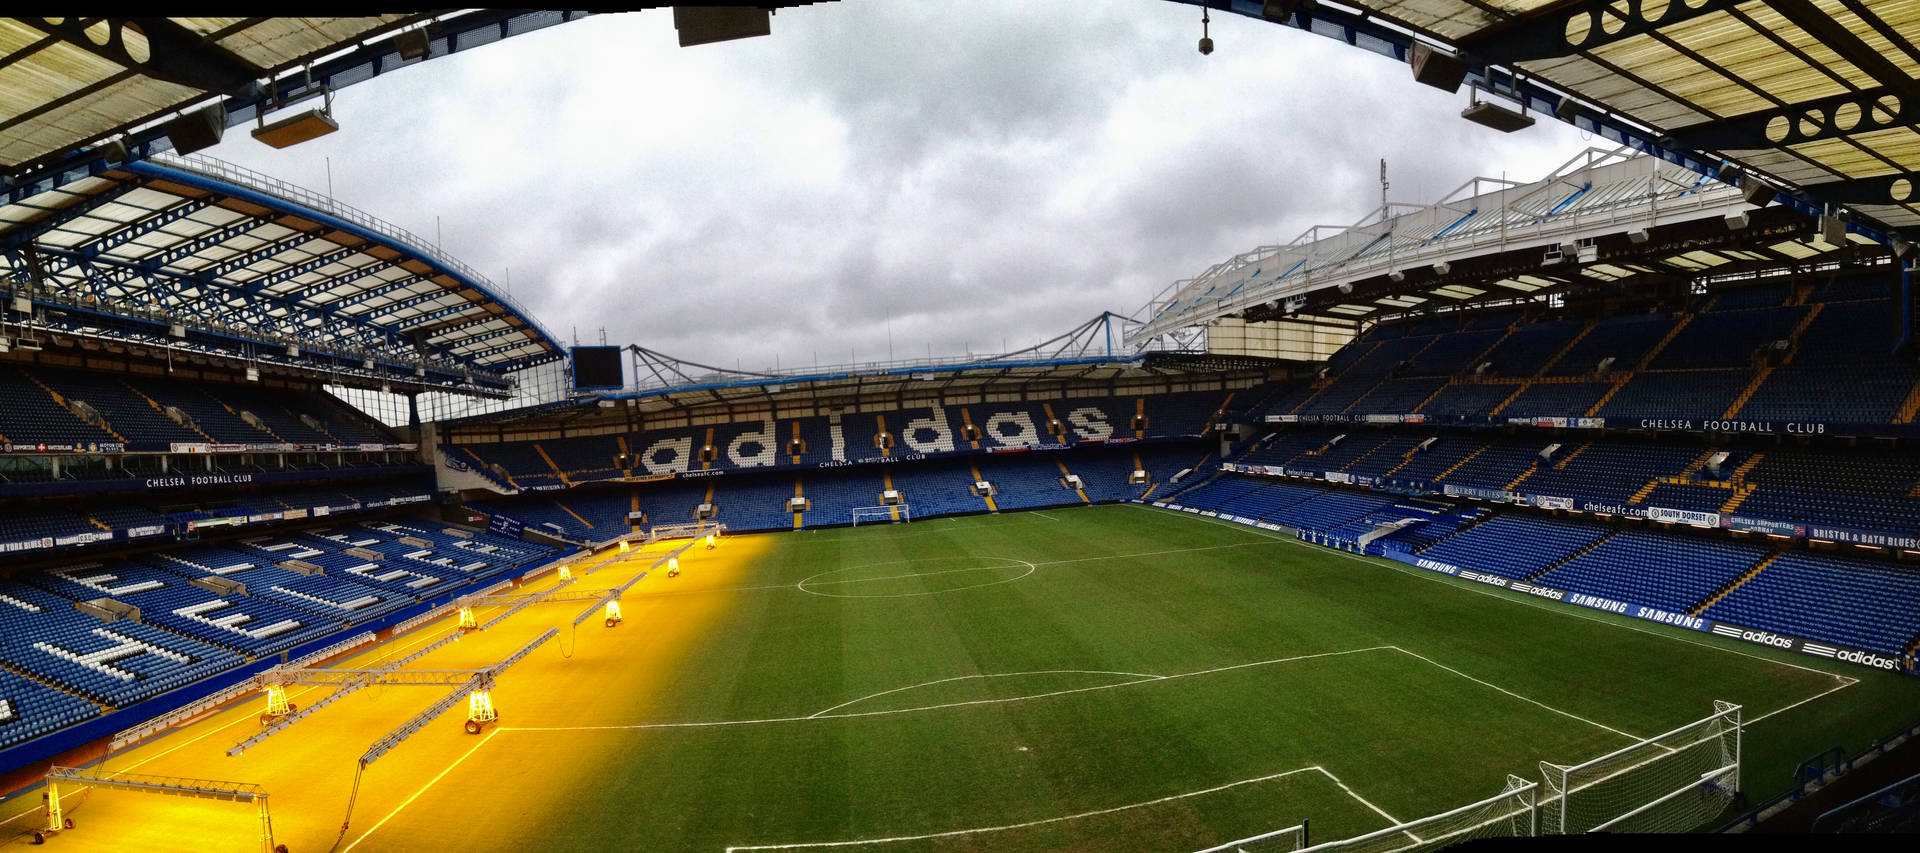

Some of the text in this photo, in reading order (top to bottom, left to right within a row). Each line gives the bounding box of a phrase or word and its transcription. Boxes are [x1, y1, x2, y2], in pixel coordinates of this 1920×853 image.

[1641, 419, 1825, 434] CHELSEA FOOTBALL CLUB
[641, 401, 1115, 474] adidas
[147, 474, 252, 488] CHELSEA FOOTBALL CLUB
[683, 470, 724, 478] chelseafc.com
[1455, 486, 1501, 499] KERRY BLUES
[1584, 501, 1649, 517] chelseafc.com
[1660, 509, 1706, 522] SOUTH DORSET
[1730, 517, 1794, 530] CHELSEA SUPPORTERS
[7, 541, 23, 552] YORK
[24, 539, 42, 550] BLUES
[1813, 528, 1917, 548] BRISTOL & BATH BLUES
[1416, 558, 1457, 574] SAMSUNG
[1477, 574, 1507, 587] adidas
[1530, 586, 1564, 600] adidas
[1570, 592, 1628, 613] SAMSUNG
[1637, 606, 1704, 629] SAMSUNG
[1742, 630, 1793, 649] adidas
[1837, 649, 1895, 670] adidas
